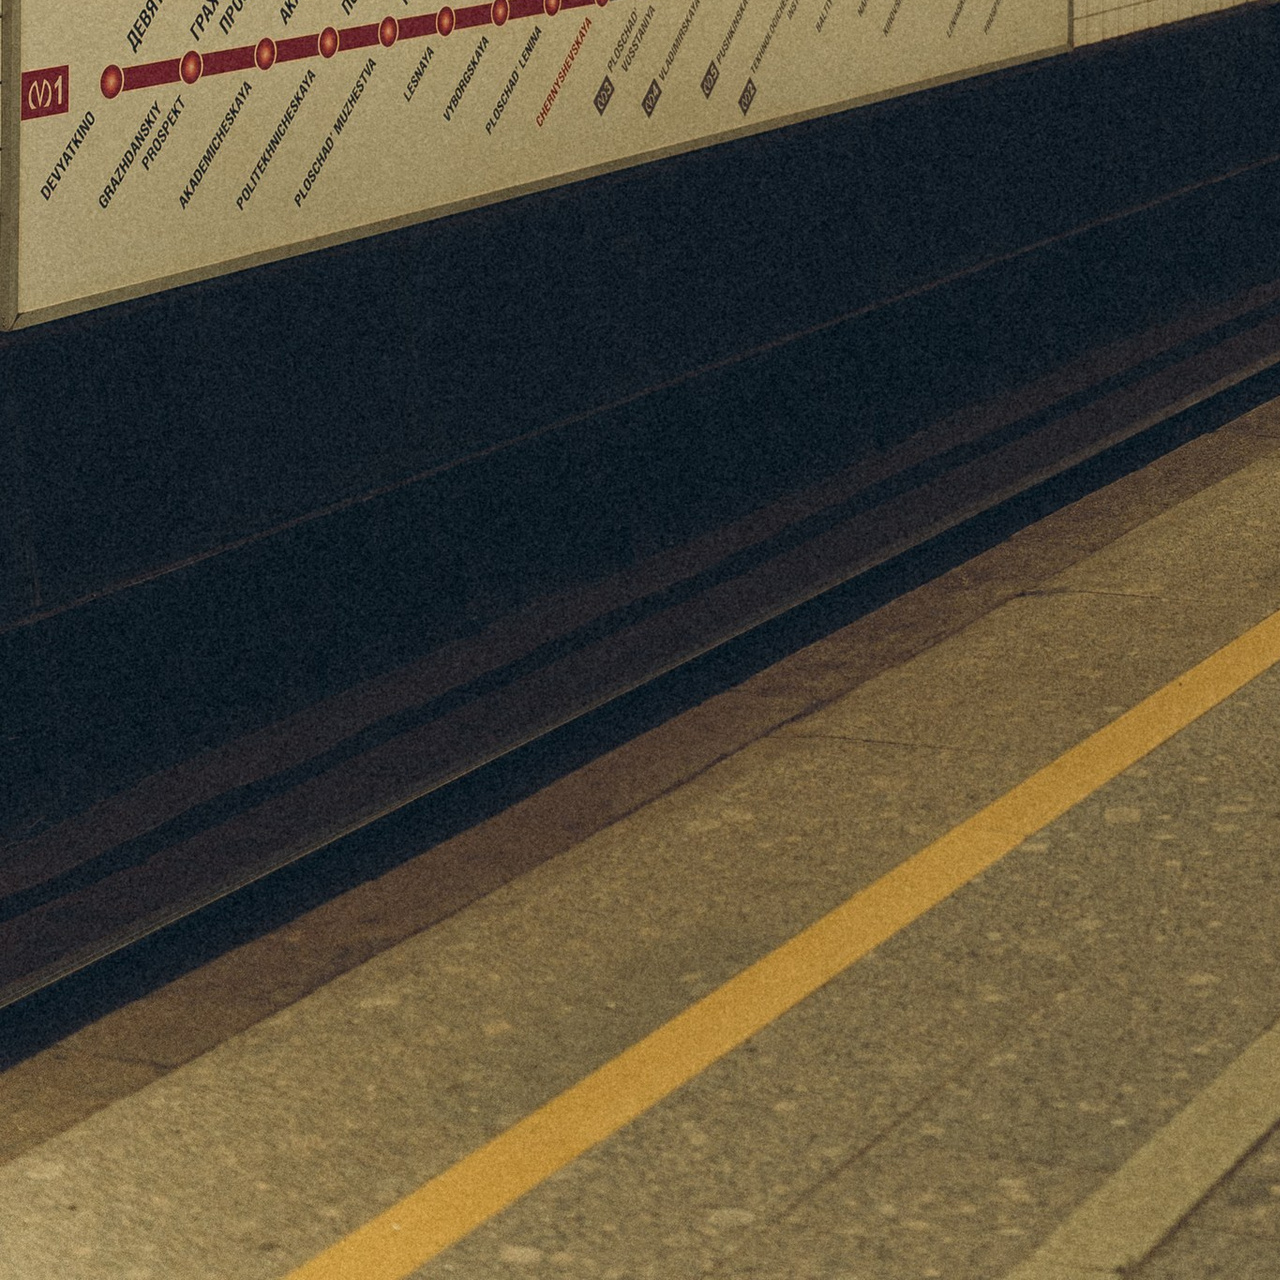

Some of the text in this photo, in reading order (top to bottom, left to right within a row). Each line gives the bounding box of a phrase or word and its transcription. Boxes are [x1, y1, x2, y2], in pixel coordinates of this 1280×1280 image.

[403, 46, 435, 103] LESNAYA
[442, 35, 490, 123] VYBORGSKAYA
[520, 25, 543, 70] LENINA
[536, 16, 593, 128] CHERNYSHEVSKAYA
[621, 4, 656, 73] VOSSTANIYA
[141, 95, 186, 171] PROSPEKT
[236, 68, 316, 211] POLITEKHNICHESKAYA
[333, 58, 377, 136] MUZHESTVA
[40, 111, 95, 201] DEVYATKINO
[98, 101, 163, 209] GRAZHDANSKIY
[178, 81, 253, 210] AKADEMICHESKAYA
